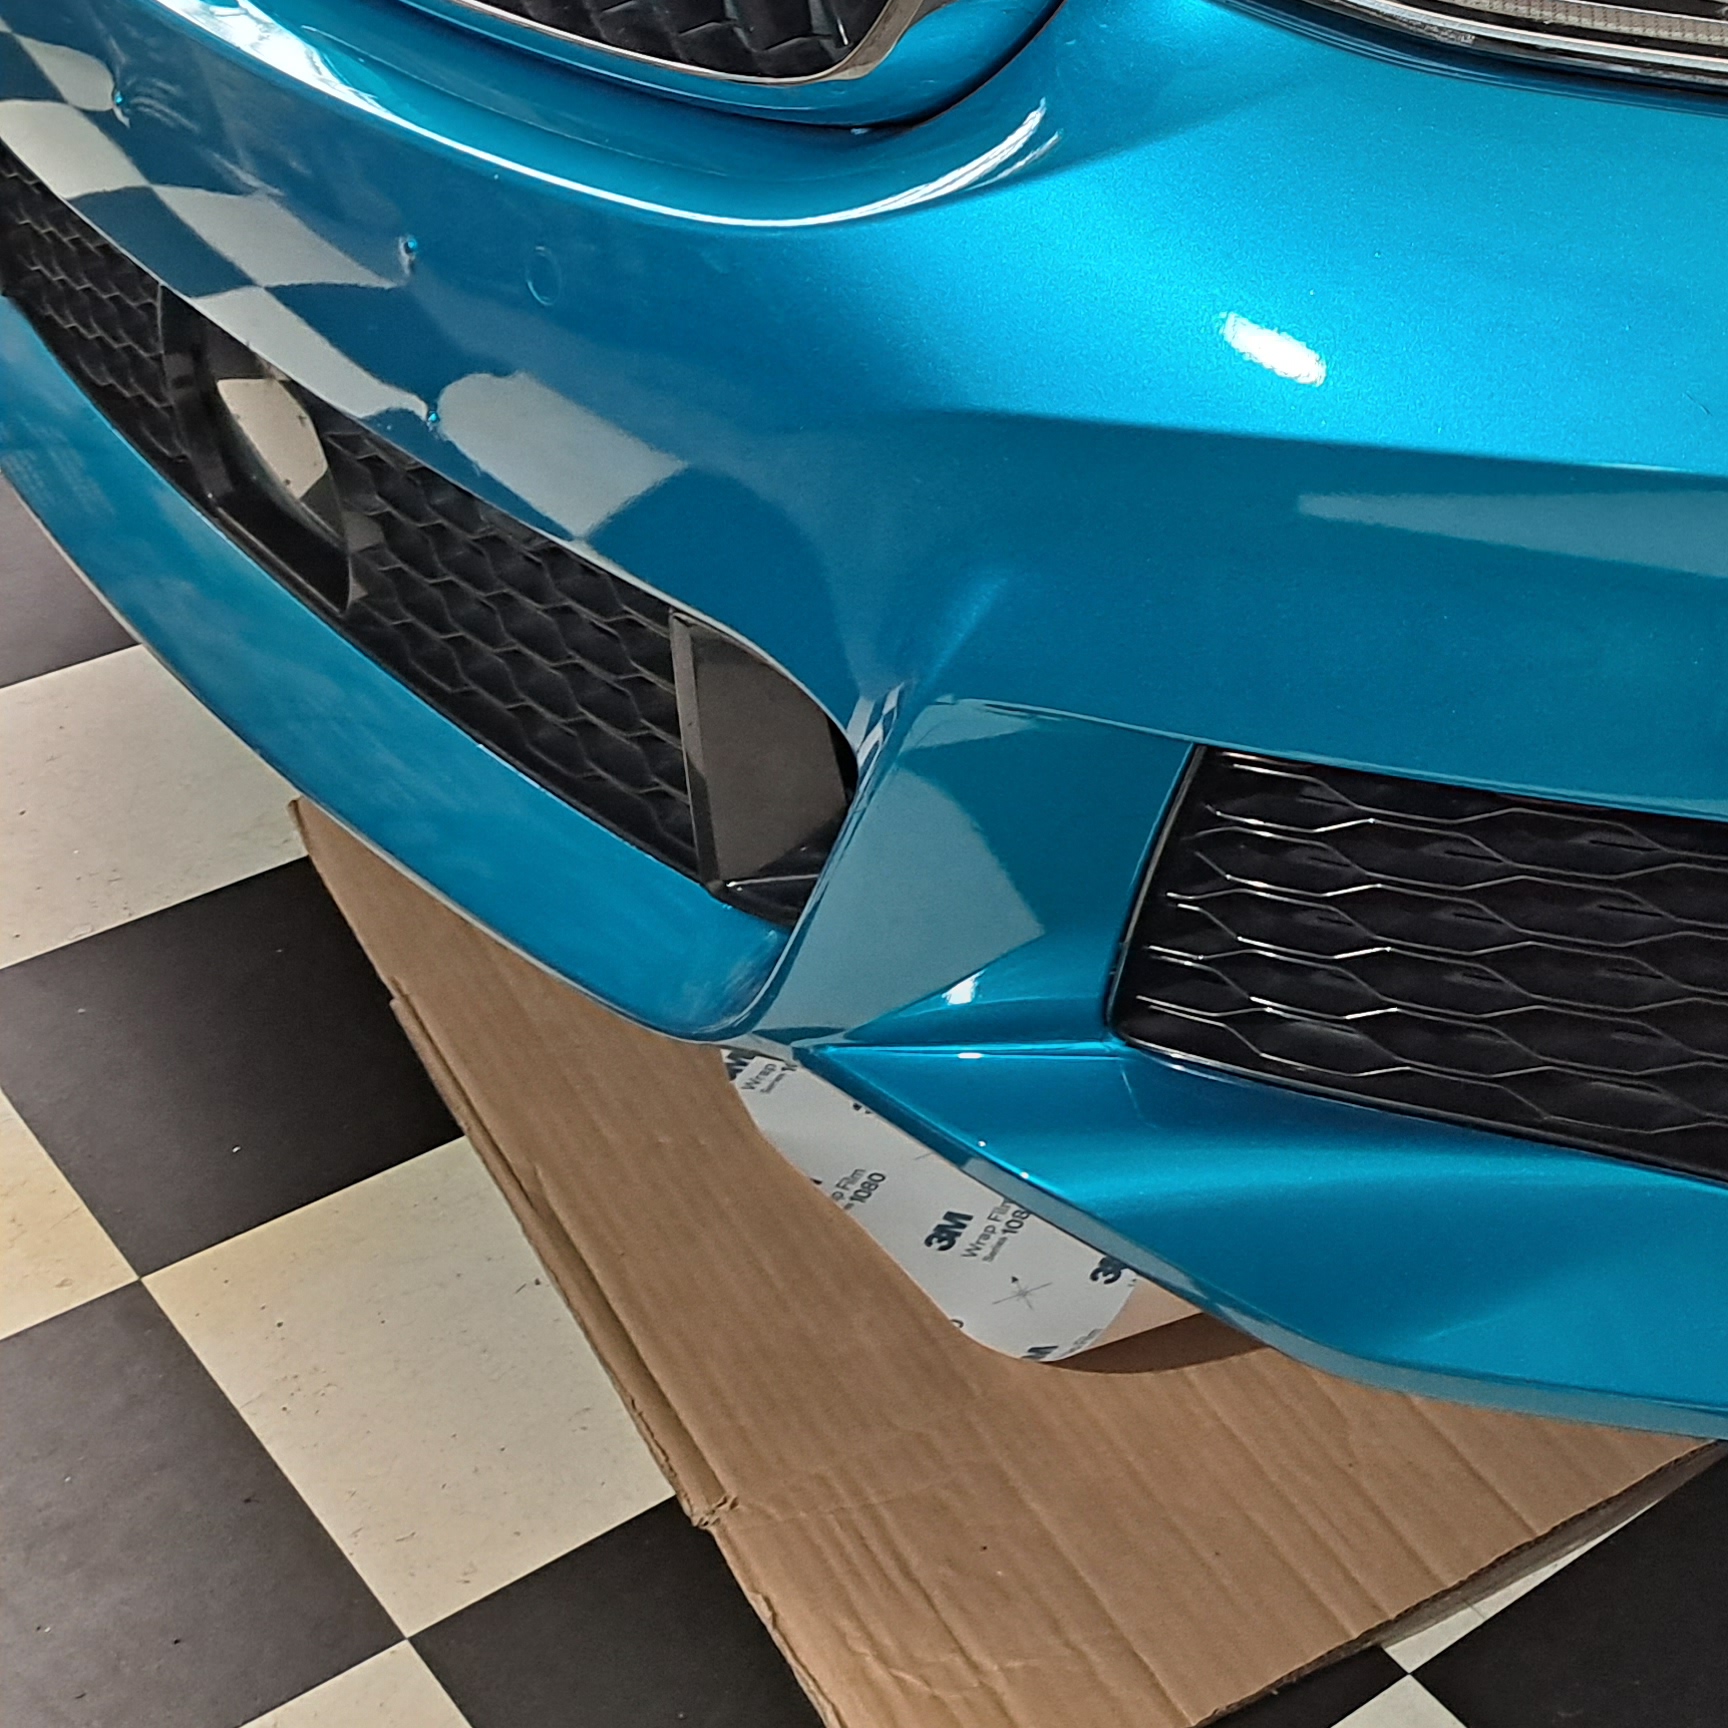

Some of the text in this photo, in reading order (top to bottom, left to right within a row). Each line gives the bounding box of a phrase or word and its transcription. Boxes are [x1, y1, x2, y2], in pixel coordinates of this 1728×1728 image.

[836, 1168, 867, 1191] Film
[850, 1172, 887, 1203] 1080
[924, 1210, 974, 1252] 3M
[1001, 1209, 1031, 1235] 108
[961, 1224, 997, 1258] Wrap
